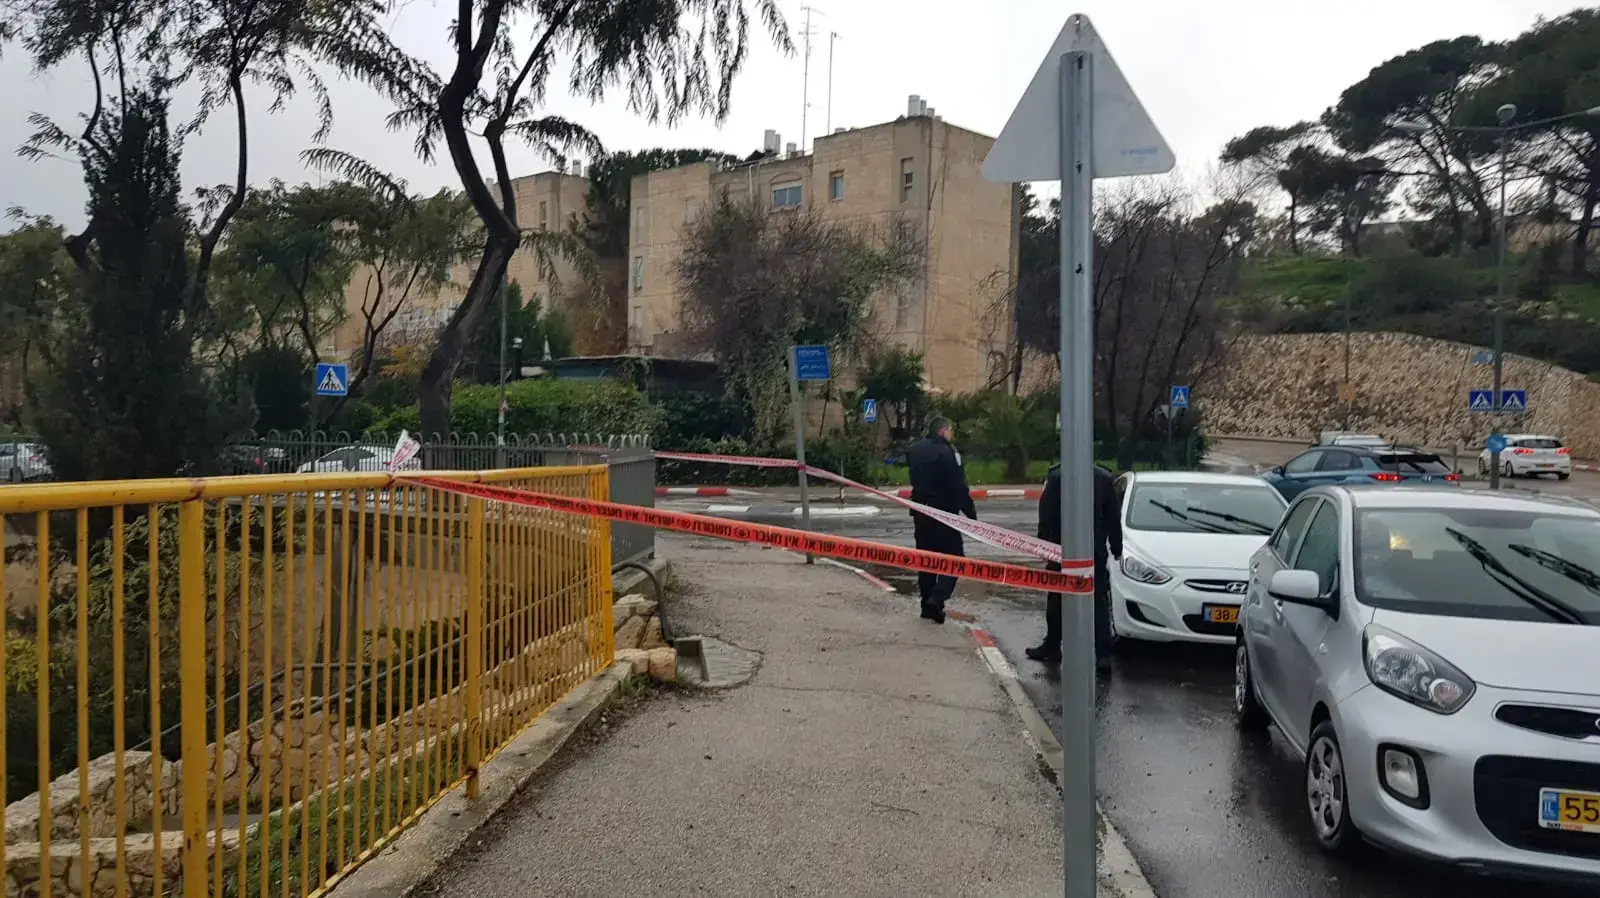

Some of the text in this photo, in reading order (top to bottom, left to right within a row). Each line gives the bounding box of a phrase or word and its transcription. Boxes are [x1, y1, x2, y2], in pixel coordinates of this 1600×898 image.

[692, 519, 732, 537] משטרת
[753, 529, 782, 546] מעבר
[784, 535, 800, 548] אין
[803, 534, 836, 554] ישראל
[855, 545, 896, 563] משטרת
[919, 554, 948, 571] מעבר
[949, 559, 966, 575] אין
[970, 561, 1005, 579] ישראל
[1024, 570, 1067, 587] משטרת
